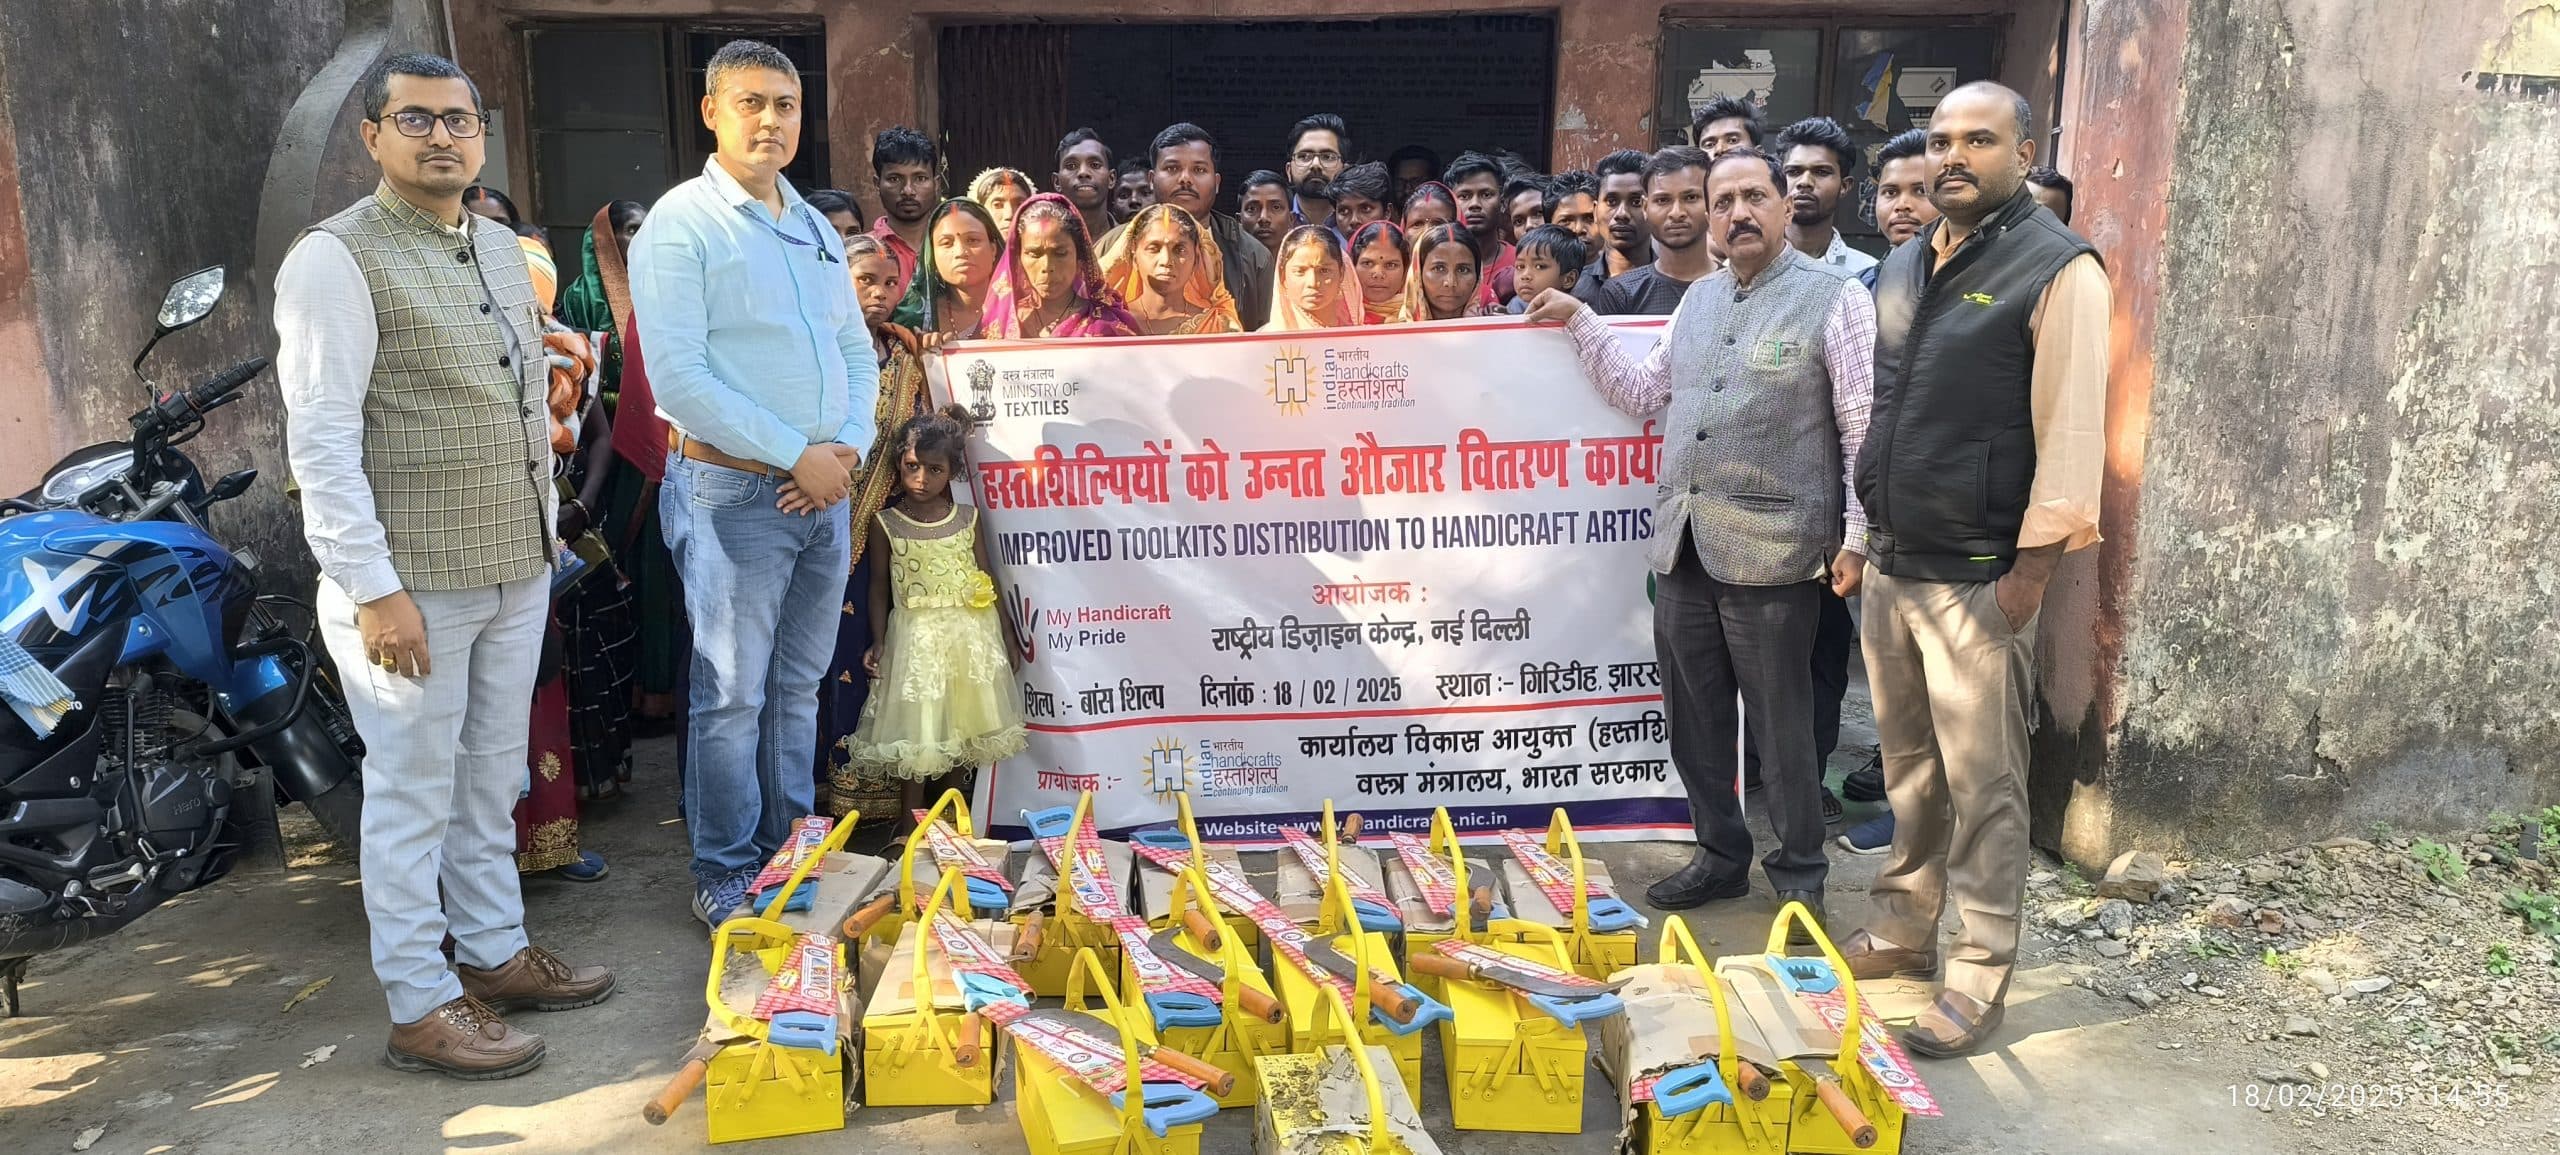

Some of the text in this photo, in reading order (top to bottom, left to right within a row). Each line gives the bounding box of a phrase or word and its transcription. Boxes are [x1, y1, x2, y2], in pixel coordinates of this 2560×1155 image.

[1337, 348, 1369, 361] भारतीय
[1323, 348, 1336, 410] indian
[1336, 361, 1409, 380] handicrafts
[1002, 382, 1080, 399] MINISTRY OF
[1004, 400, 1069, 417] TEXTILES
[1337, 398, 1415, 411] continuing tradition
[978, 419, 1664, 510] हस्तशिल्पियों को उन्नत औजार वितरण कार्य
[998, 508, 1656, 566] IMPROVED TOOLKITS DISTRIBUTION TO HANDICRAFT ARTIS
[1312, 574, 1412, 606] आयोजक
[1046, 604, 1172, 629] My Handicraft
[1048, 628, 1126, 652] My Pride
[1211, 617, 1275, 660] राष्ट्रीय
[1280, 615, 1363, 653] डिज़ाइन
[1431, 609, 1465, 646] नई
[1470, 607, 1531, 641] दिल्ली
[1023, 682, 1056, 718] शिल्प
[1078, 682, 1114, 716] बांस
[1119, 677, 1165, 712] शिल्प
[1199, 675, 1255, 707] दिनांक
[1273, 680, 1293, 706] 18
[1313, 679, 1336, 705] 02
[1356, 676, 1402, 703] 2025
[1435, 673, 1492, 700] स्थान
[1213, 739, 1244, 751] भारतीय
[1298, 725, 1397, 758] कार्यालय
[1404, 723, 1484, 756] विकास
[1491, 723, 1577, 761] आयुक्त
[1199, 739, 1212, 797] indian
[1211, 752, 1282, 769] handicrafts
[1037, 766, 1100, 793] प्रायोजक
[1214, 784, 1288, 797] continuing tradition
[1356, 772, 1408, 796] वस्त्र
[1522, 764, 1582, 789] भारत
[1589, 759, 1669, 785] सरकार
[1203, 821, 1278, 837] Website
